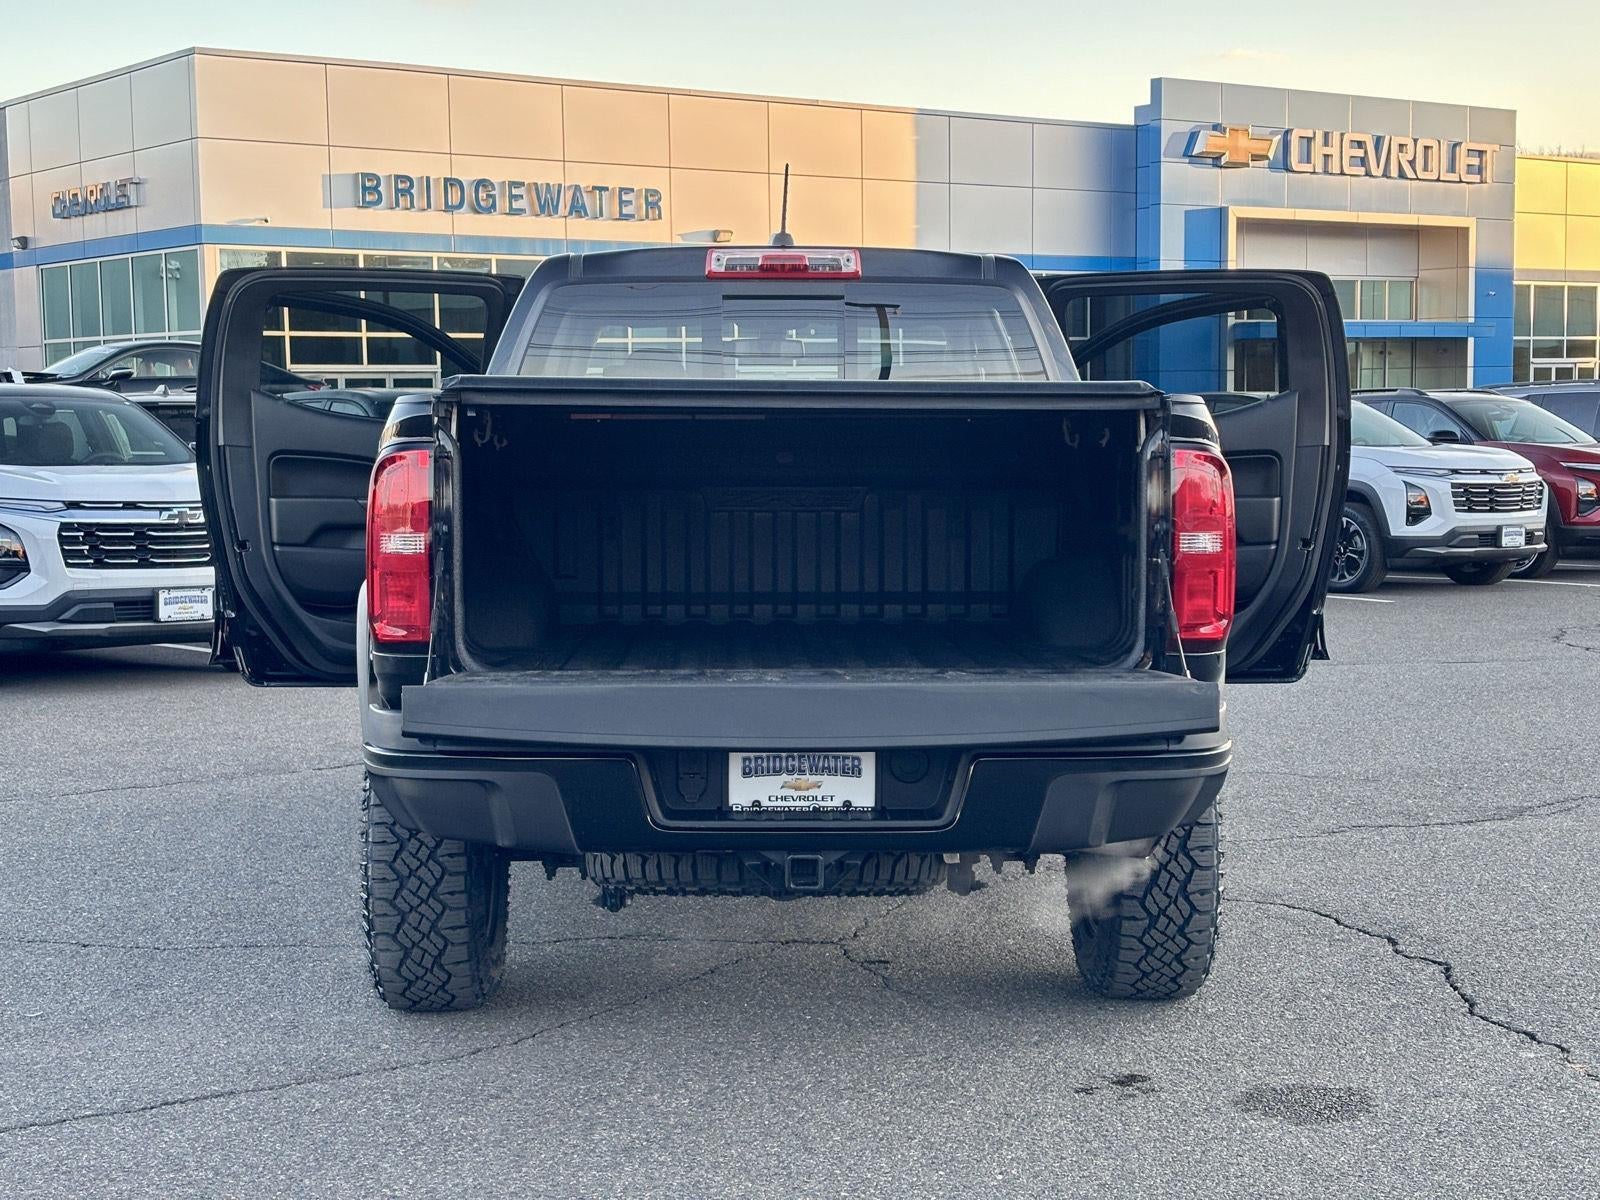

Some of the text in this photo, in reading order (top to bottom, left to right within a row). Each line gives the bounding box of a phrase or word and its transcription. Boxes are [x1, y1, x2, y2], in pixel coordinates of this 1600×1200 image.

[1290, 128, 1501, 184] CHEVROLET
[51, 176, 140, 219] CHEVROLET
[357, 171, 663, 220] BRIDGEWATER
[741, 753, 863, 778] BRIDGEWATER
[768, 794, 835, 802] CHEVROLET
